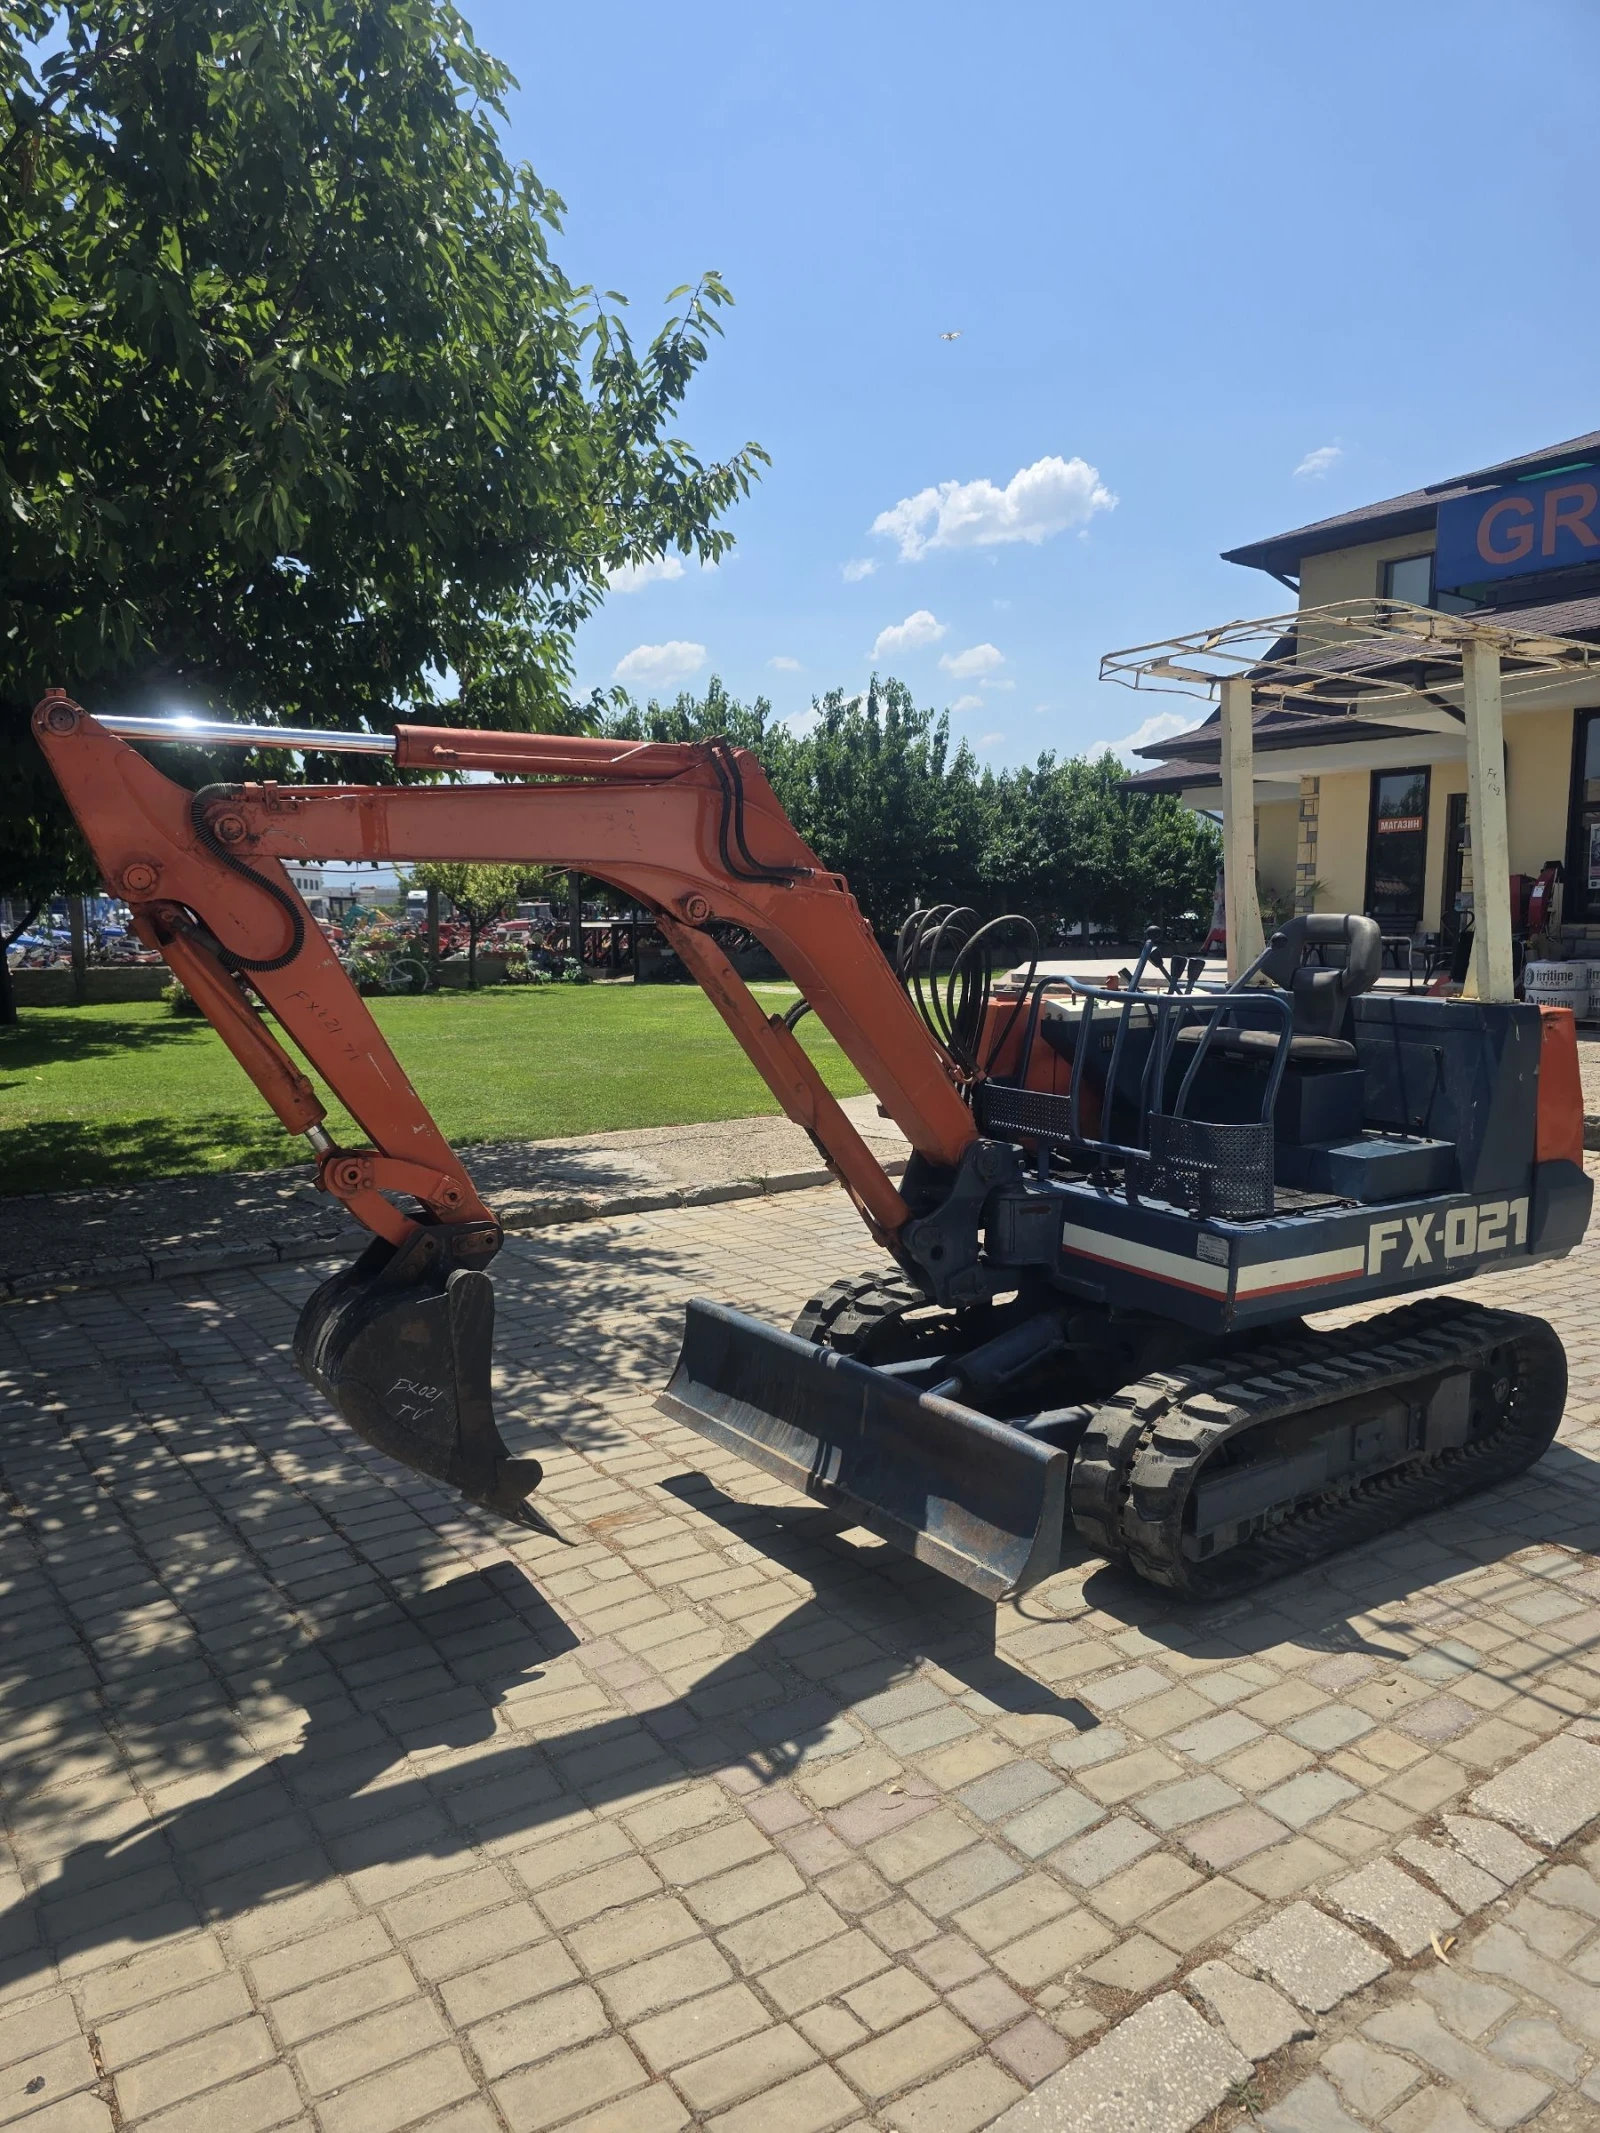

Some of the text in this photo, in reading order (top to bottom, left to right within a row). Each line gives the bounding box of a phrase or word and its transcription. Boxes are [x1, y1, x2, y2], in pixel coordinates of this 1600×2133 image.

[1476, 483, 1600, 565] GR
[1380, 819, 1420, 831] МАГАЗИН
[1536, 969, 1574, 981] irritime
[1367, 1196, 1530, 1276] FX-021
[384, 1378, 444, 1403] FX021
